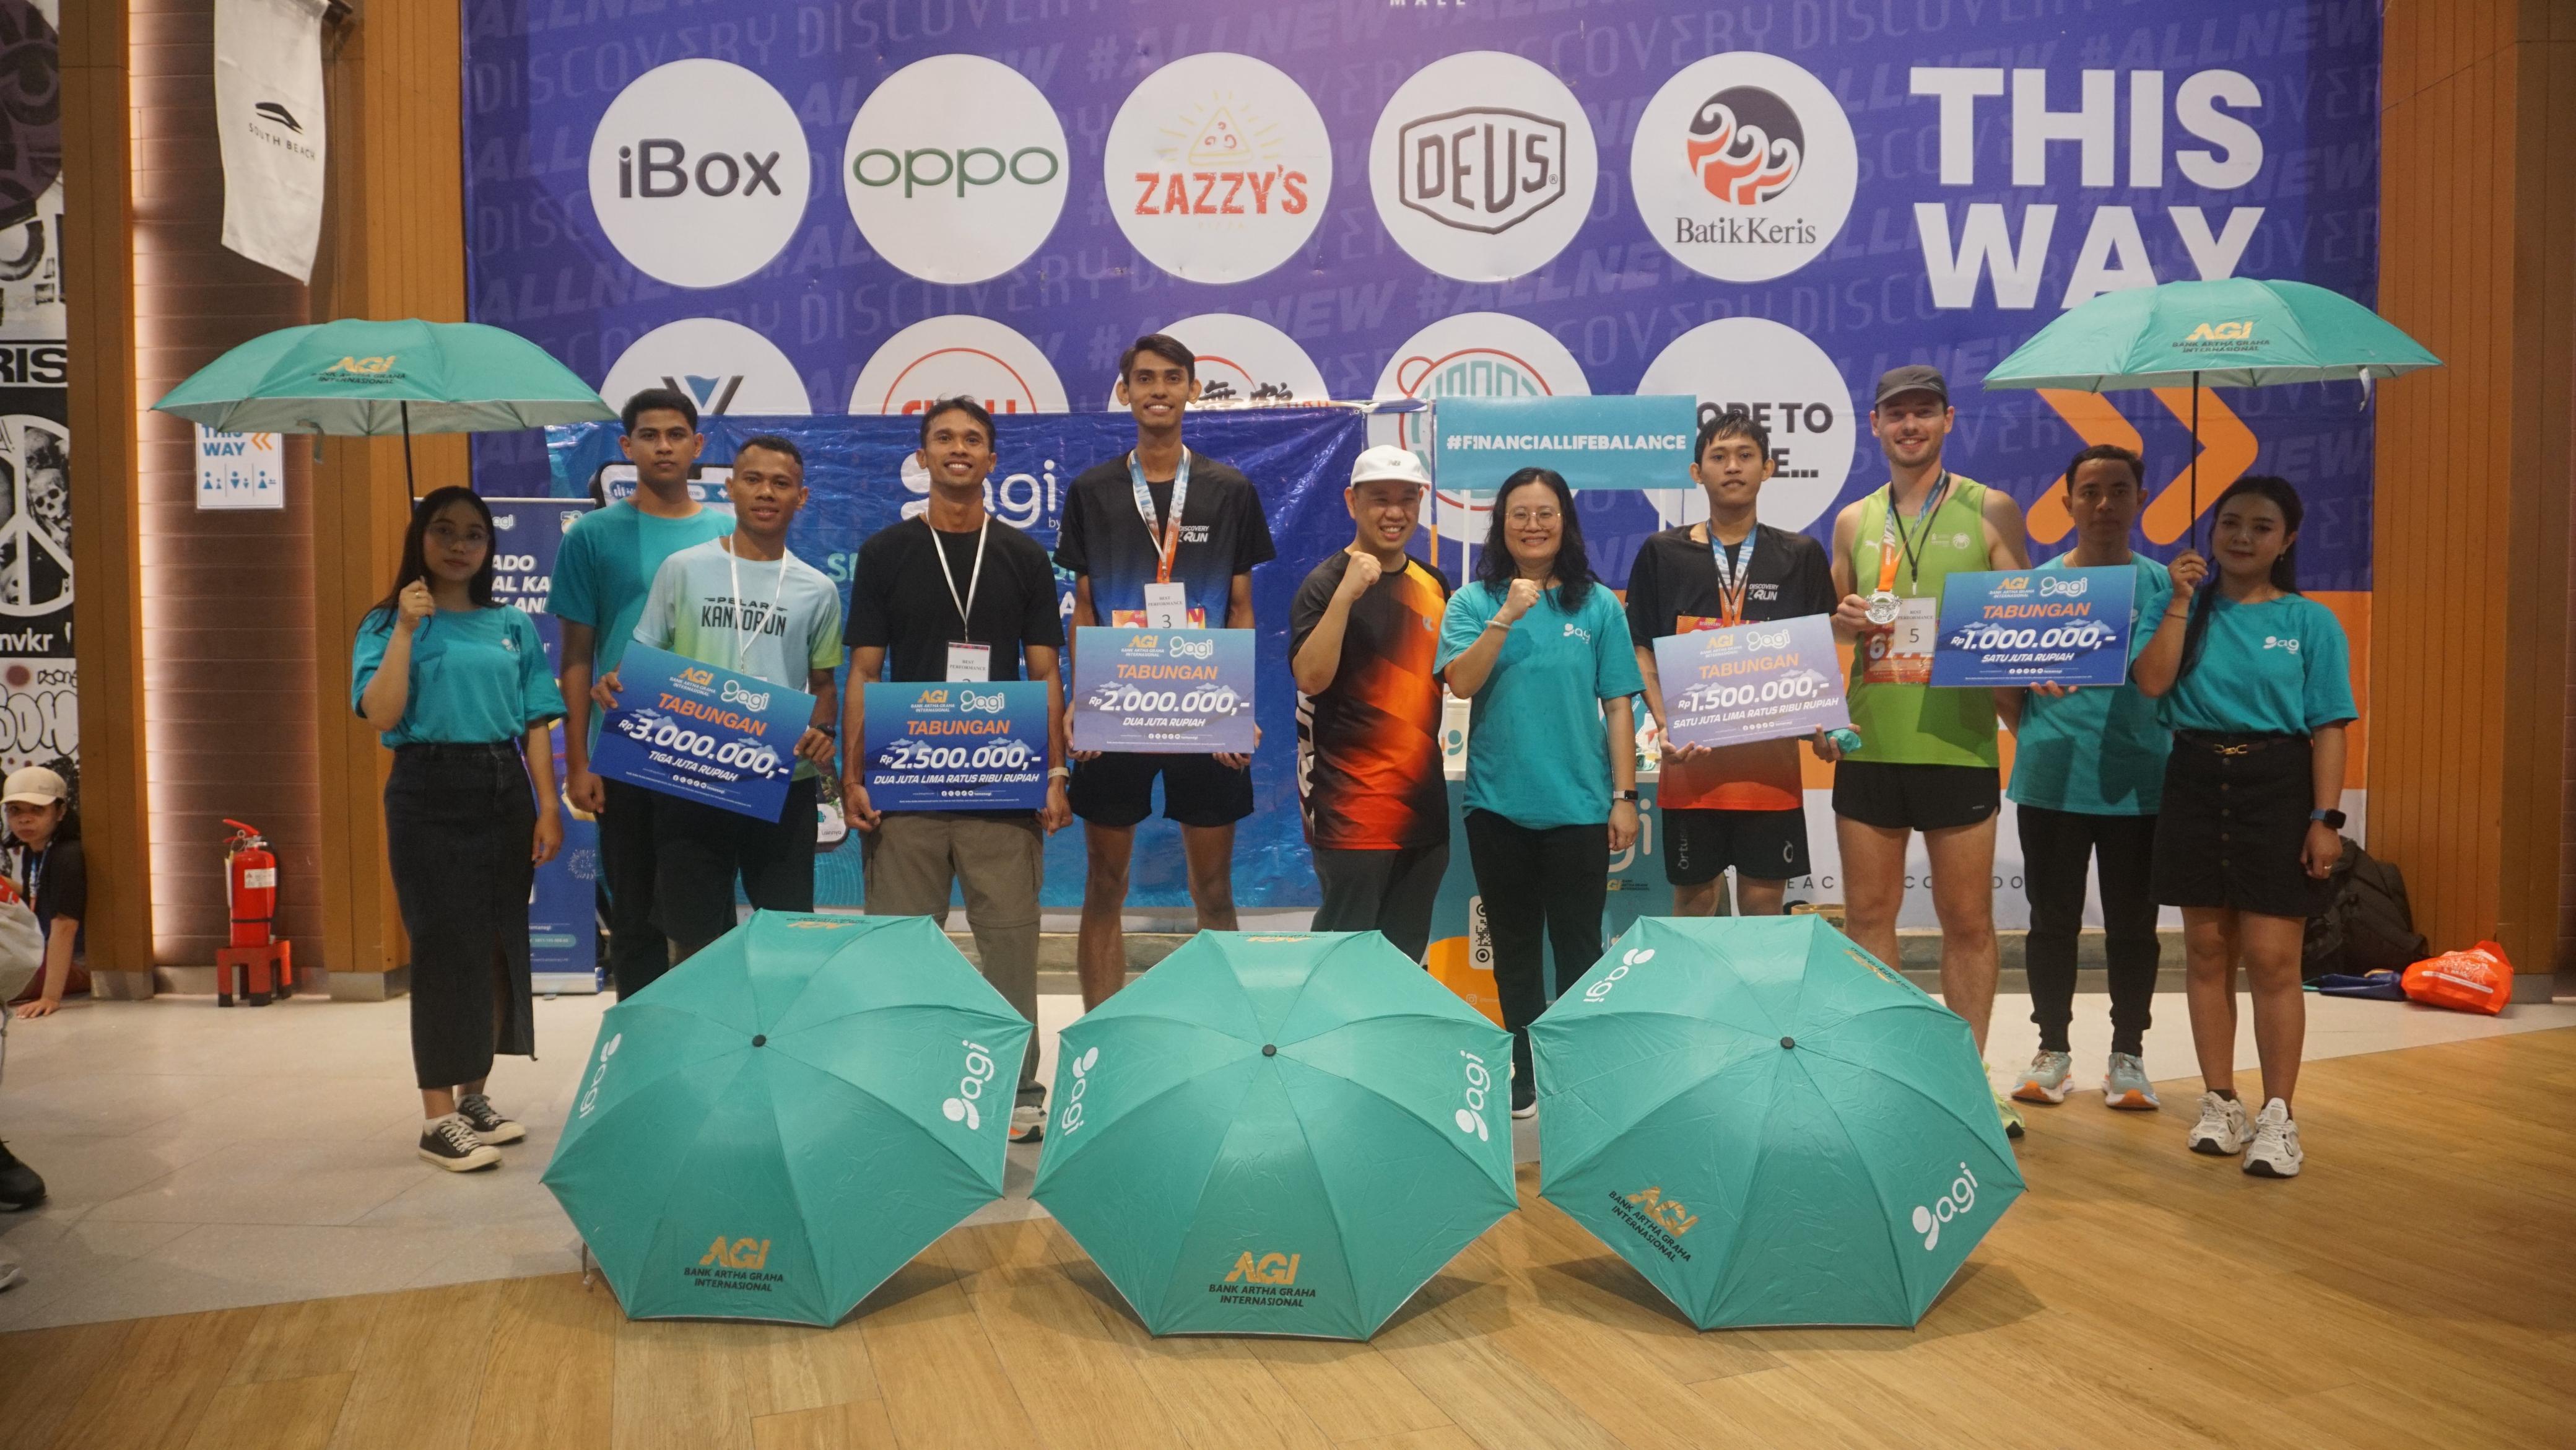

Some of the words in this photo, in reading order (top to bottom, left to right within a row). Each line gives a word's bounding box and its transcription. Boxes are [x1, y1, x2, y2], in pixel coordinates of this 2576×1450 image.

[1910, 66, 2264, 190] THIS
[249, 123, 281, 146] SOUTH
[286, 140, 316, 161] BEACH
[619, 139, 782, 198] iBox
[852, 147, 1059, 199] oppo
[1418, 123, 1549, 213] DEUS
[1134, 164, 1308, 215] ZAZZY'S
[1914, 203, 2266, 310] WAY
[2185, 321, 2253, 341] AGI
[326, 356, 396, 373] AGI
[1778, 402, 1834, 434] TO
[203, 442, 245, 456] WAY
[1447, 435, 1686, 450] #FINANCIALLIFEBALANCE
[1996, 577, 2029, 590] AGI
[1982, 602, 2091, 619] TABUNGAN
[1162, 614, 1172, 629] 3
[1129, 635, 1159, 647] AGI
[1705, 634, 1734, 649] AGI
[1909, 628, 1920, 644] 5
[1699, 653, 1799, 679] TABUNGAN
[1982, 653, 2007, 663] SATU
[2008, 653, 2033, 662] JUTA
[2034, 652, 2074, 662] RUPIAH
[680, 667, 715, 686] AGI
[1116, 664, 1219, 680] TABUNGAN
[918, 689, 949, 703] AGI
[658, 692, 768, 737] TABUNGAN
[1673, 718, 1698, 728] SATU
[1698, 715, 1721, 726] JUTA
[1723, 712, 1746, 722] LIMA
[1747, 707, 1778, 718] RATUS
[1779, 703, 1802, 714] RIBU
[1803, 697, 1838, 710] RUPIAH
[907, 720, 1011, 735] TABUNGAN
[1123, 717, 1143, 726] DUA
[1144, 717, 1167, 726] JUTA
[1168, 717, 1206, 727] RUPIAH
[648, 751, 673, 765] TIGA
[672, 758, 698, 773] JUTA
[699, 765, 739, 782] RUPIAH
[874, 775, 895, 784] DUA
[896, 775, 918, 784] JUTA
[921, 775, 944, 784] LIMA
[946, 774, 977, 783] RATUS
[978, 774, 1001, 782] RIBU
[1003, 774, 1040, 782] RUPIAH
[1626, 1186, 1699, 1239] AGI
[1609, 1190, 1634, 1212] BANK
[1632, 1212, 1662, 1237] ARTHA
[1661, 1234, 1692, 1262] GRAHA
[1611, 1205, 1677, 1262] INTERNASIONAL
[699, 1236, 771, 1269] AGI
[684, 1268, 712, 1276] BANK
[715, 1270, 747, 1280] ARTHA
[749, 1272, 784, 1283] GRAHA
[1224, 1251, 1300, 1285] AGI
[694, 1278, 772, 1292] INTERNASIONAL
[1209, 1284, 1239, 1293] BANK
[1241, 1286, 1277, 1296] ARTHA
[1279, 1288, 1316, 1298] GRAHA
[1220, 1295, 1304, 1308] INTERNASIONAL
